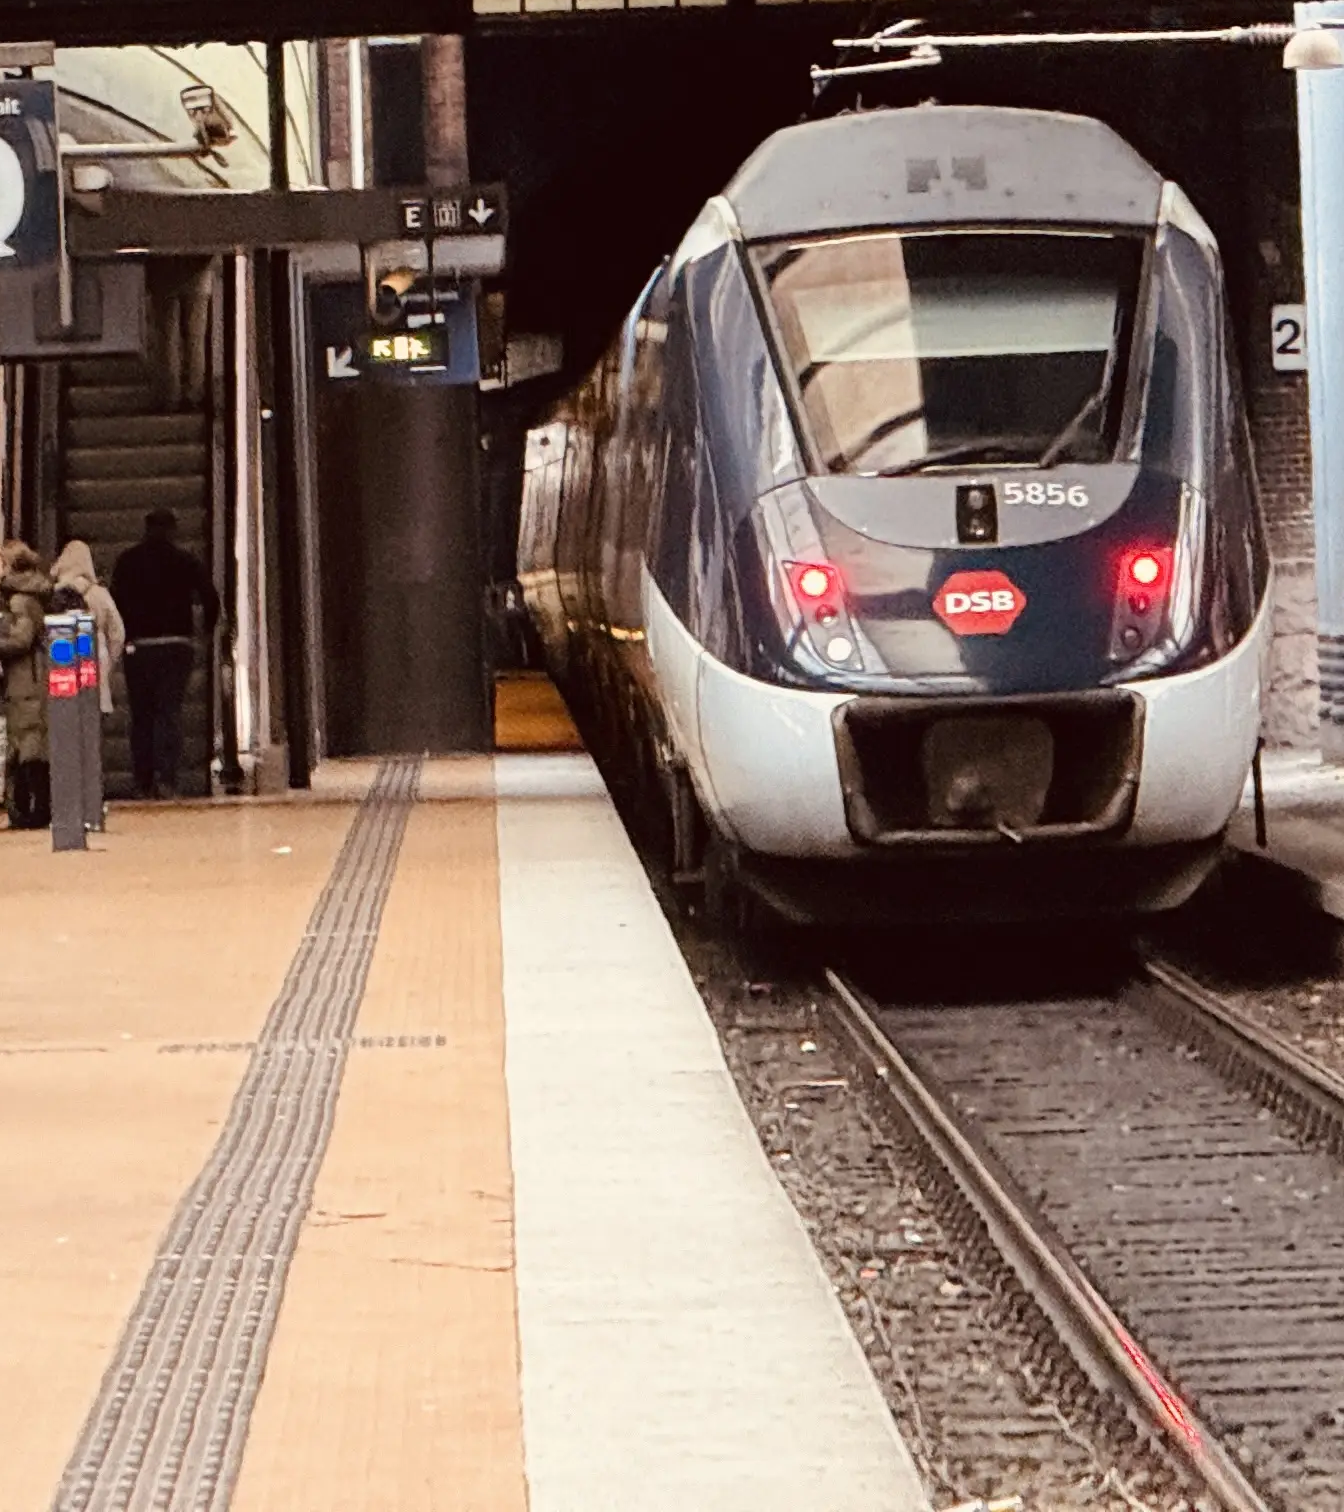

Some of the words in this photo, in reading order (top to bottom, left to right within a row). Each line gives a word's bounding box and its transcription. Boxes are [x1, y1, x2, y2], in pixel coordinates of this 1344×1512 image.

[406, 206, 422, 229] E
[1003, 482, 1090, 508] 5856
[944, 590, 1015, 614] DSB
